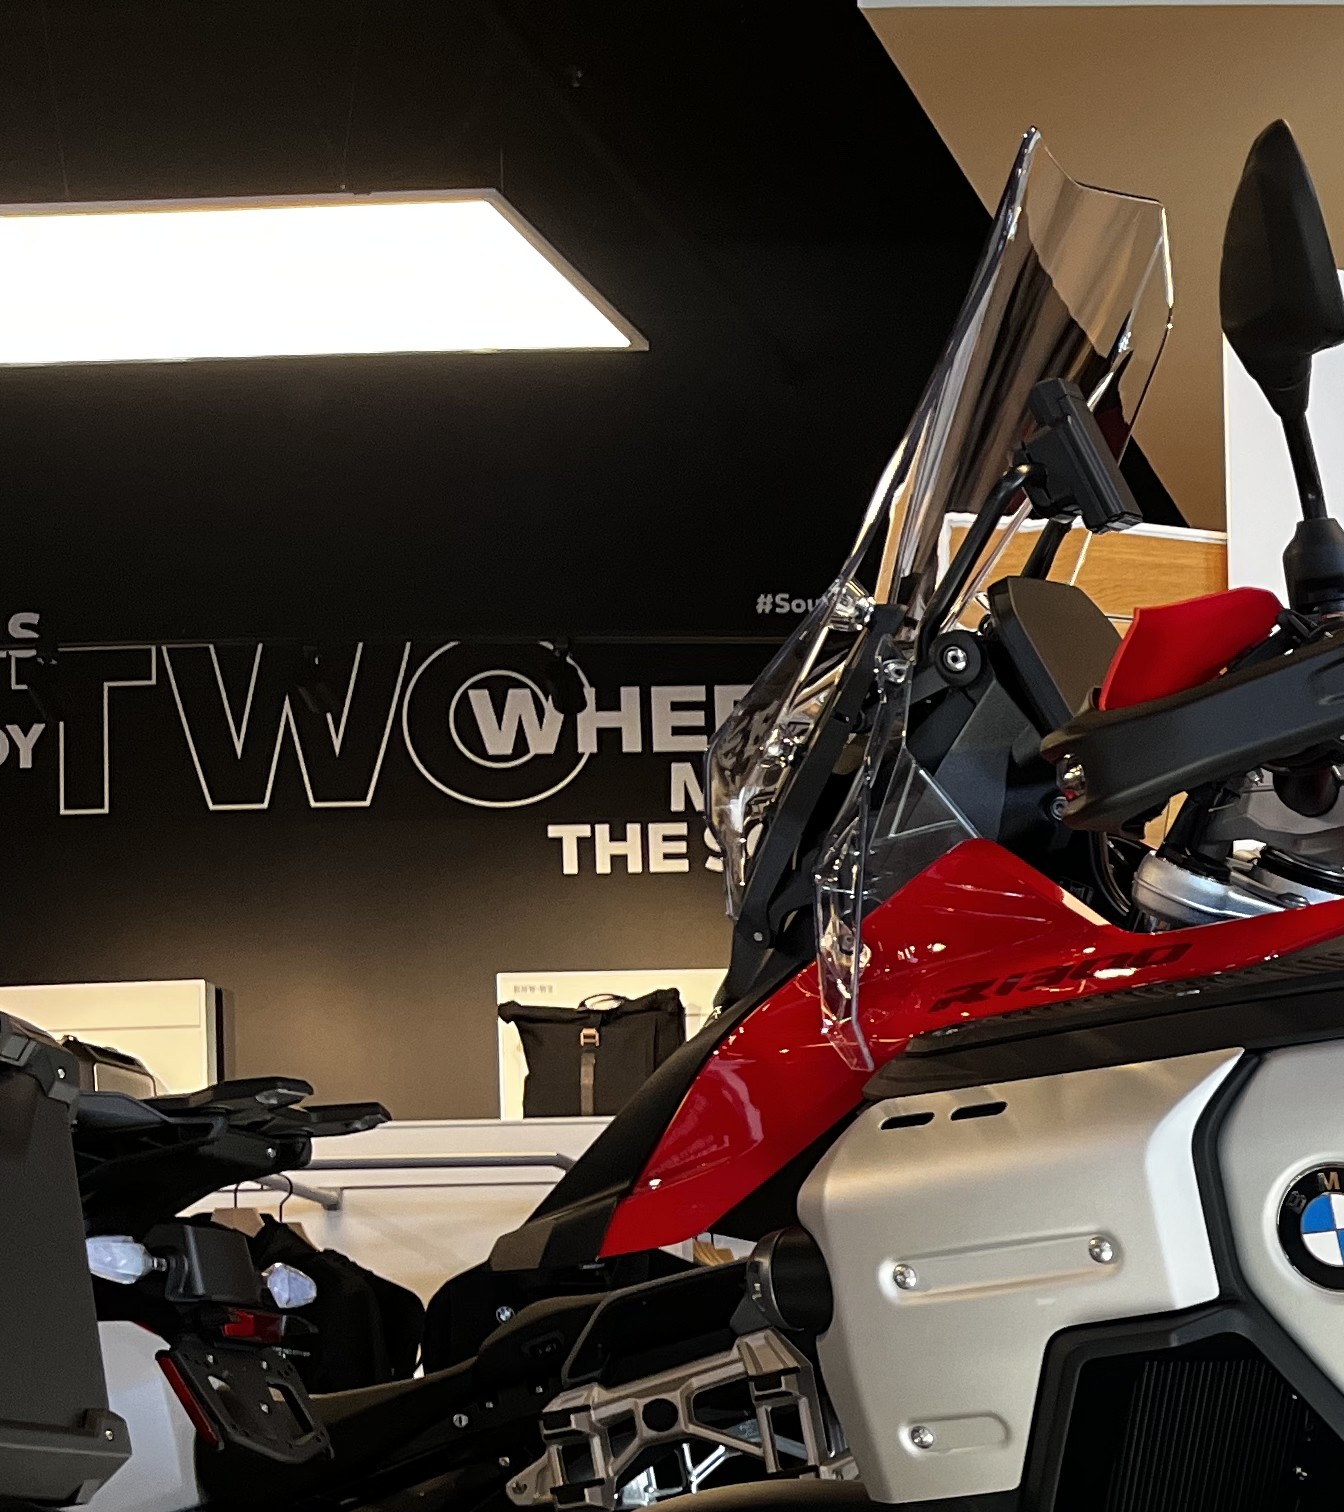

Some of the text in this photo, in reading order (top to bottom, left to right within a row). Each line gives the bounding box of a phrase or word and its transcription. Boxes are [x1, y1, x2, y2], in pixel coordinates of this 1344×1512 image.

[756, 593, 829, 614] #Sou
[11, 641, 594, 815] TWO
[547, 823, 689, 875] THE
[928, 943, 1193, 1013] R1300
